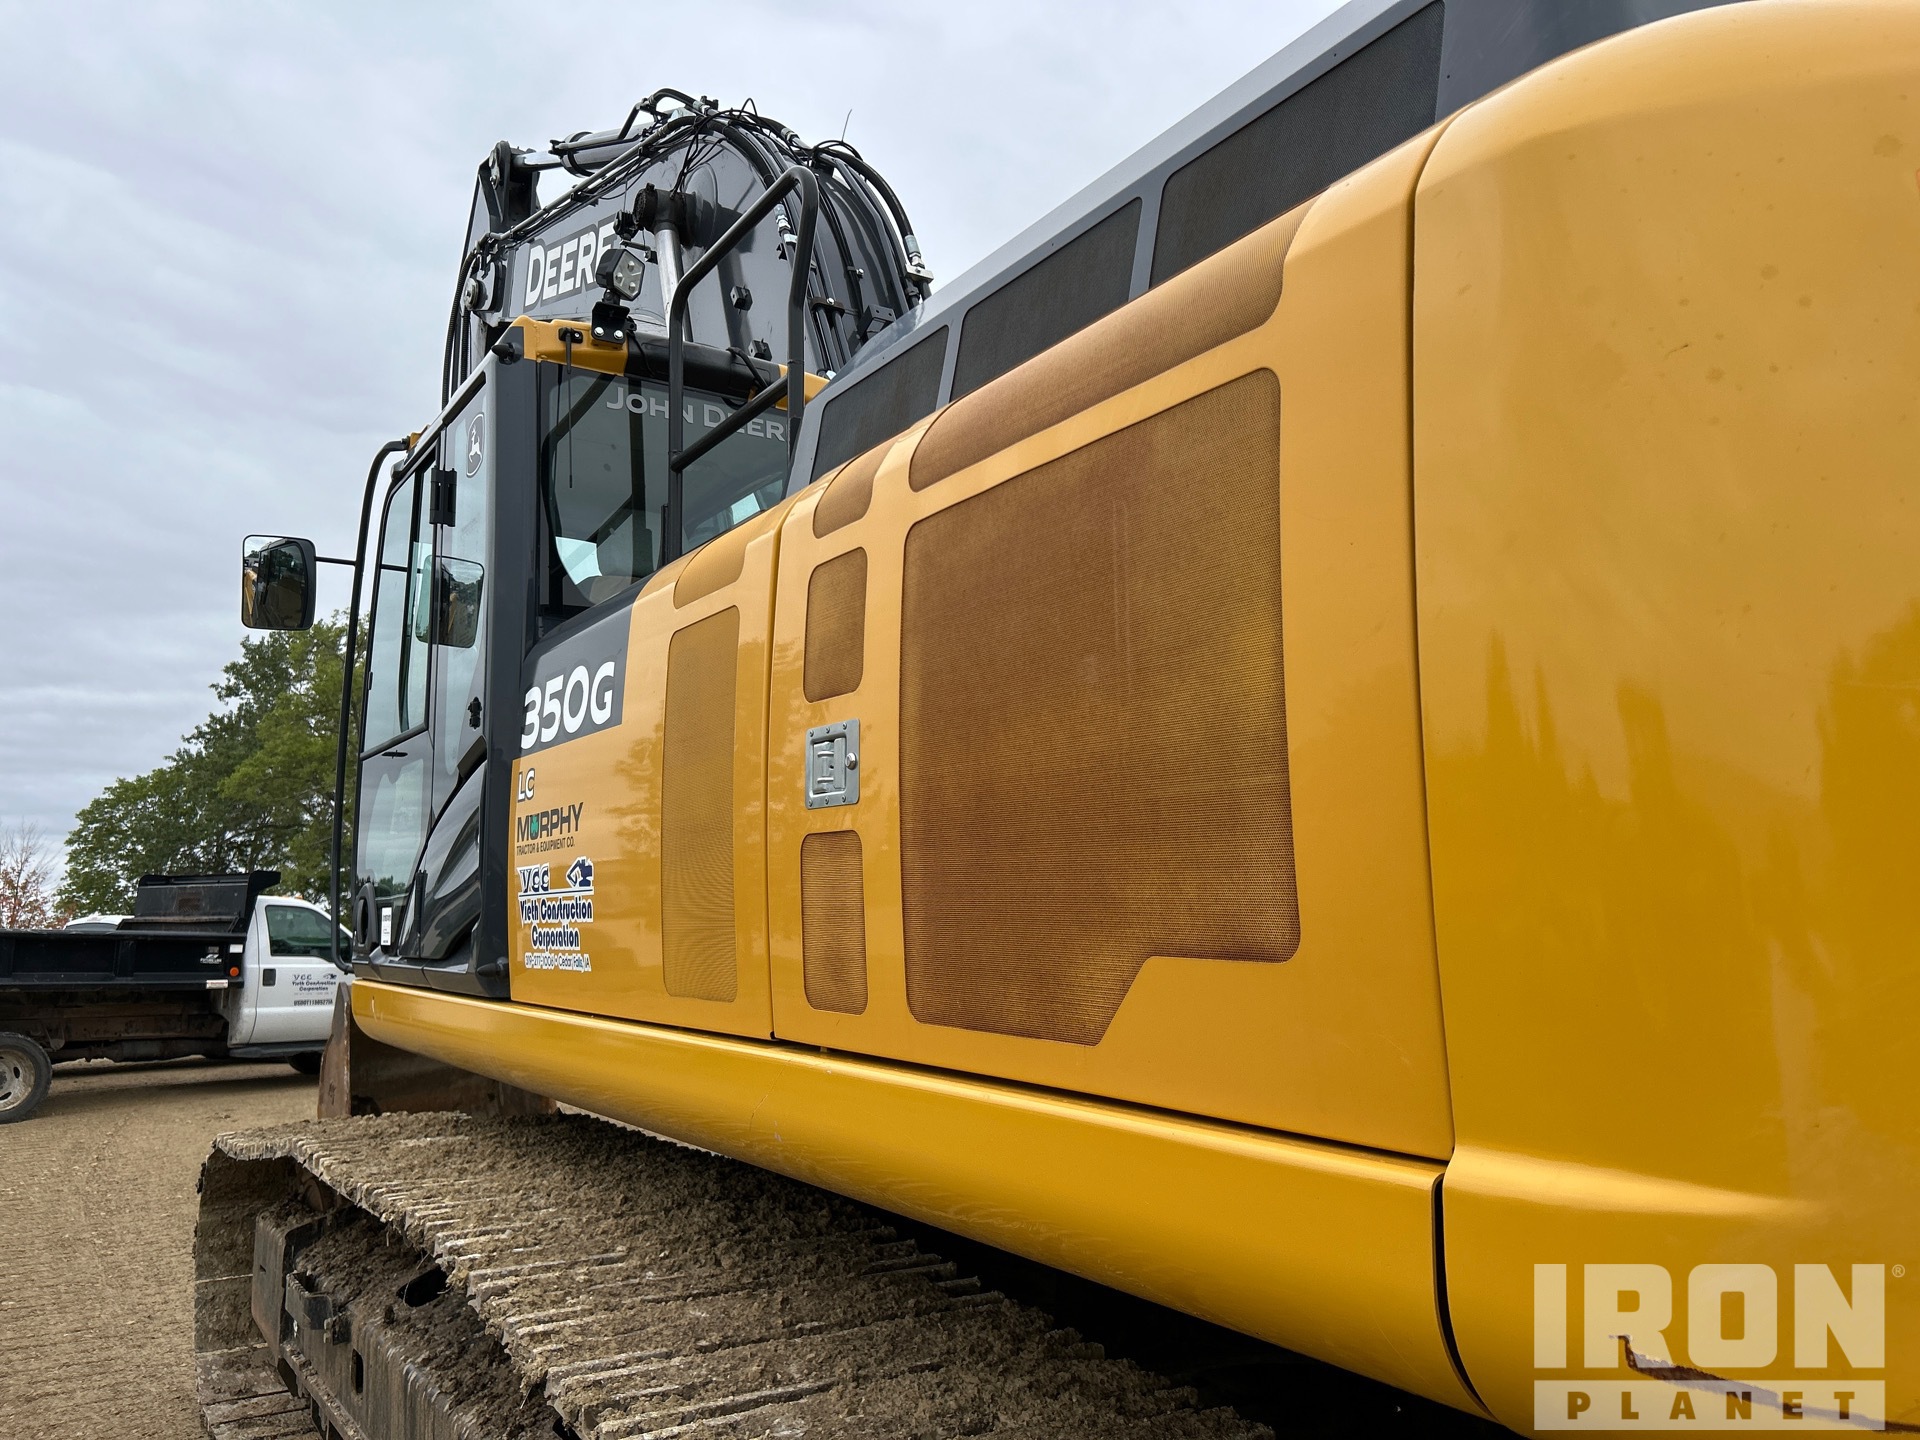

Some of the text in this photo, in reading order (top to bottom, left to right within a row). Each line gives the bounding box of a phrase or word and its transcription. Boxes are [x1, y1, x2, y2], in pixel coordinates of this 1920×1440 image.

[606, 387, 788, 442] JOHN DER
[521, 661, 615, 749] 350G
[517, 767, 536, 803] LC
[516, 801, 584, 843] MURPHY
[516, 842, 536, 856] TRACTOR
[540, 837, 566, 852] EQUIPMENT
[520, 865, 550, 894] VCC
[520, 896, 593, 921] Vieth Construction
[531, 924, 580, 952] Corporation
[558, 954, 572, 967] Cedar
